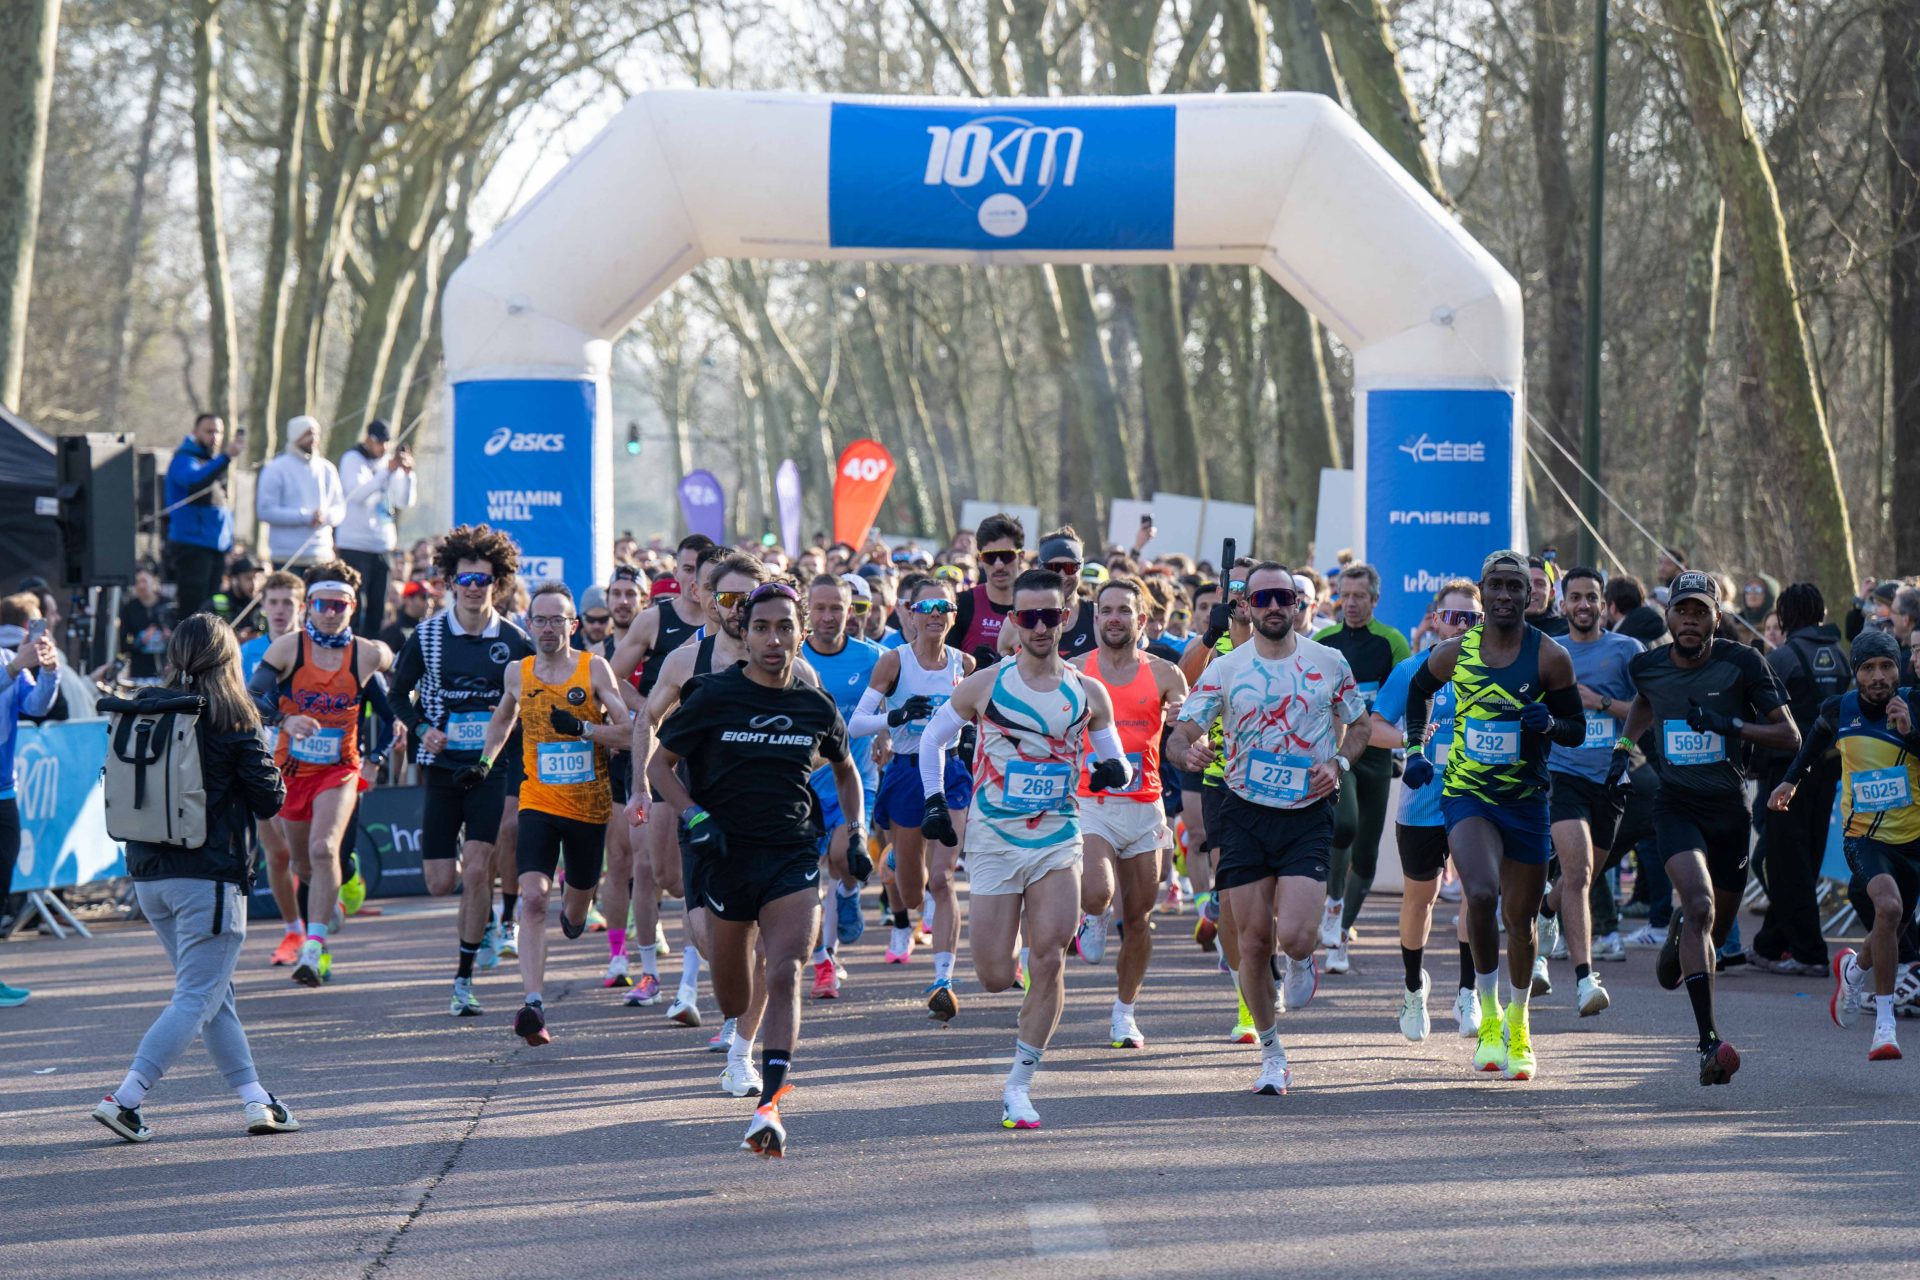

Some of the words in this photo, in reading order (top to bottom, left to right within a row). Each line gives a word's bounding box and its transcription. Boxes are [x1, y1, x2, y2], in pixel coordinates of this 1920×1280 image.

[487, 490, 563, 507] VITAMIN
[487, 505, 533, 521] WELL
[1389, 511, 1491, 525] FINISHERS
[458, 725, 483, 739] 568
[721, 731, 765, 743] EIGHT
[768, 734, 813, 746] LINES
[299, 739, 332, 753] 1405
[1475, 734, 1504, 751] 292
[1674, 735, 1712, 750] 5697
[549, 755, 585, 772] 3109
[1262, 767, 1293, 785] 273
[1022, 778, 1054, 796] 268
[1862, 782, 1899, 800] 6025
